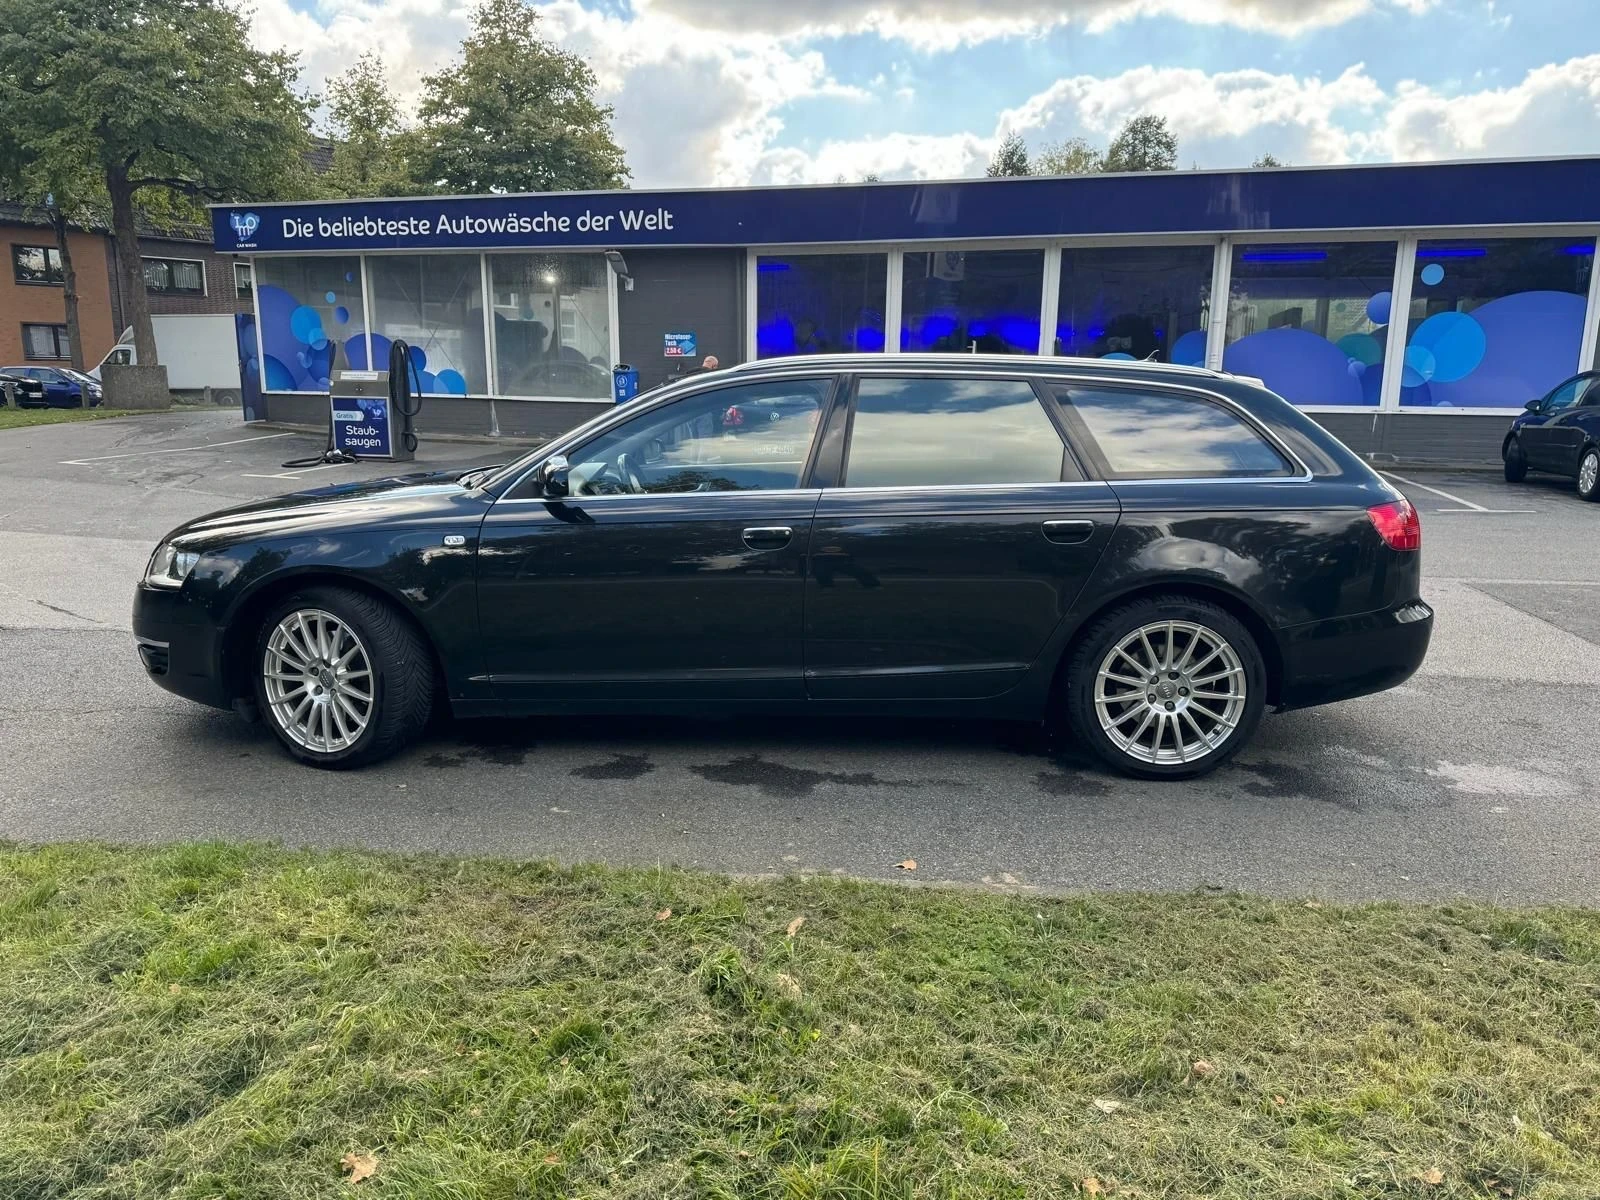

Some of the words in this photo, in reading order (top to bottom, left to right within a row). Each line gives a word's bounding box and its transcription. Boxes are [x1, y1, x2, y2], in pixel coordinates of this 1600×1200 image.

[282, 218, 314, 238] Die
[318, 215, 431, 238] beliebteste
[436, 211, 570, 234] Autowäsche
[576, 210, 614, 232] der
[619, 207, 674, 231] Welt
[345, 425, 380, 436] Staub-
[344, 438, 381, 448] saugen
